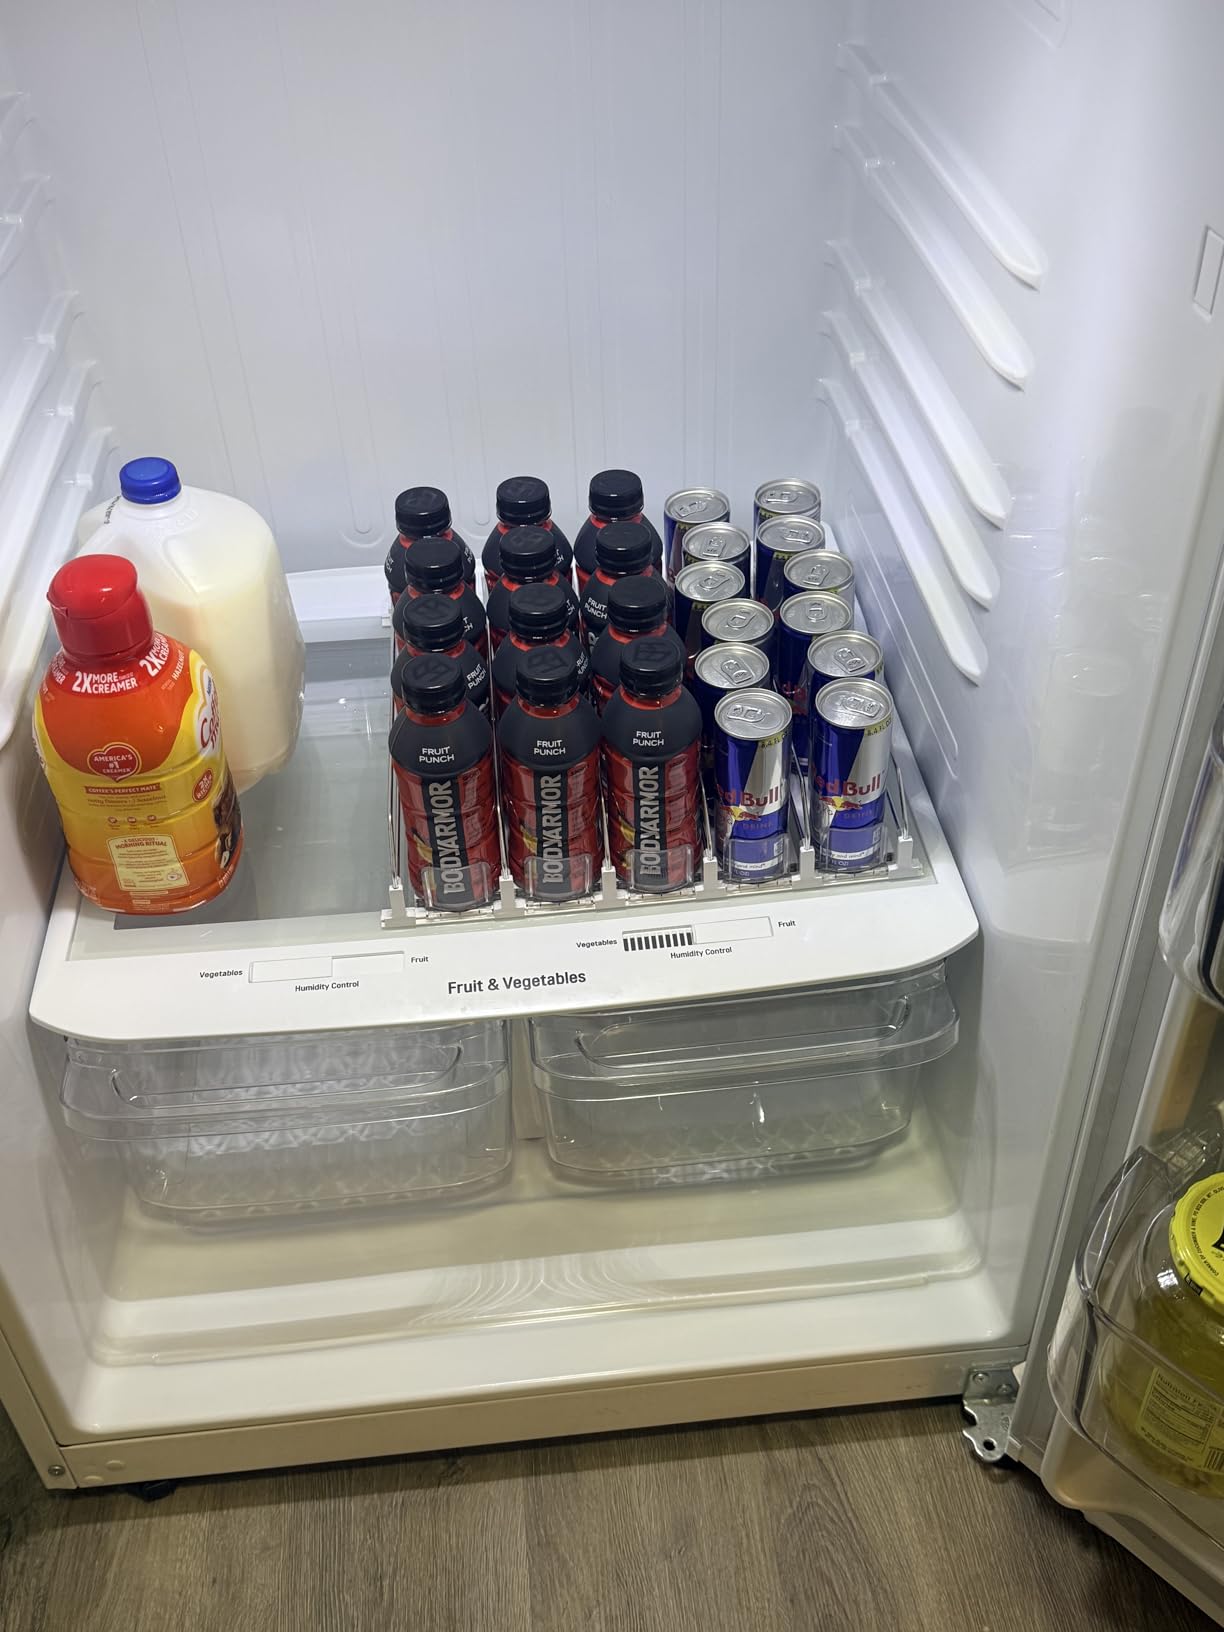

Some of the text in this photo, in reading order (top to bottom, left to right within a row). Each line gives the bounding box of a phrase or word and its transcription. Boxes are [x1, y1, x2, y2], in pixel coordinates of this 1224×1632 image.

[588, 597, 608, 611] FRUIT
[585, 604, 608, 619] PUNCH
[139, 651, 166, 677] 2X
[92, 672, 119, 684] MORE
[466, 663, 482, 681] FRUIT
[467, 668, 486, 690] PUNCH
[72, 670, 93, 694] 2X
[92, 677, 138, 694] CREAMER
[636, 730, 662, 739] FRUIT
[537, 739, 562, 748] FRUIT
[633, 738, 664, 747] PUNCH
[94, 754, 133, 762] AMERICA'S
[422, 746, 450, 756] FRUIT
[534, 747, 566, 756] PUNCH
[419, 754, 455, 764] PUNCH
[842, 774, 881, 796] Bull
[741, 786, 779, 807] Bull
[639, 766, 661, 875] BODYARMOR
[541, 774, 564, 883] BODYARMOR
[429, 780, 466, 894] BODYARMOR
[778, 920, 796, 928] Fruit
[576, 938, 618, 948] Vegetables
[410, 955, 429, 964] Fruit
[670, 946, 733, 960] Humidity Control
[200, 969, 244, 979] Vegetables
[295, 980, 360, 993] Humidity Control
[448, 971, 587, 994] Fruit & Vegetables
